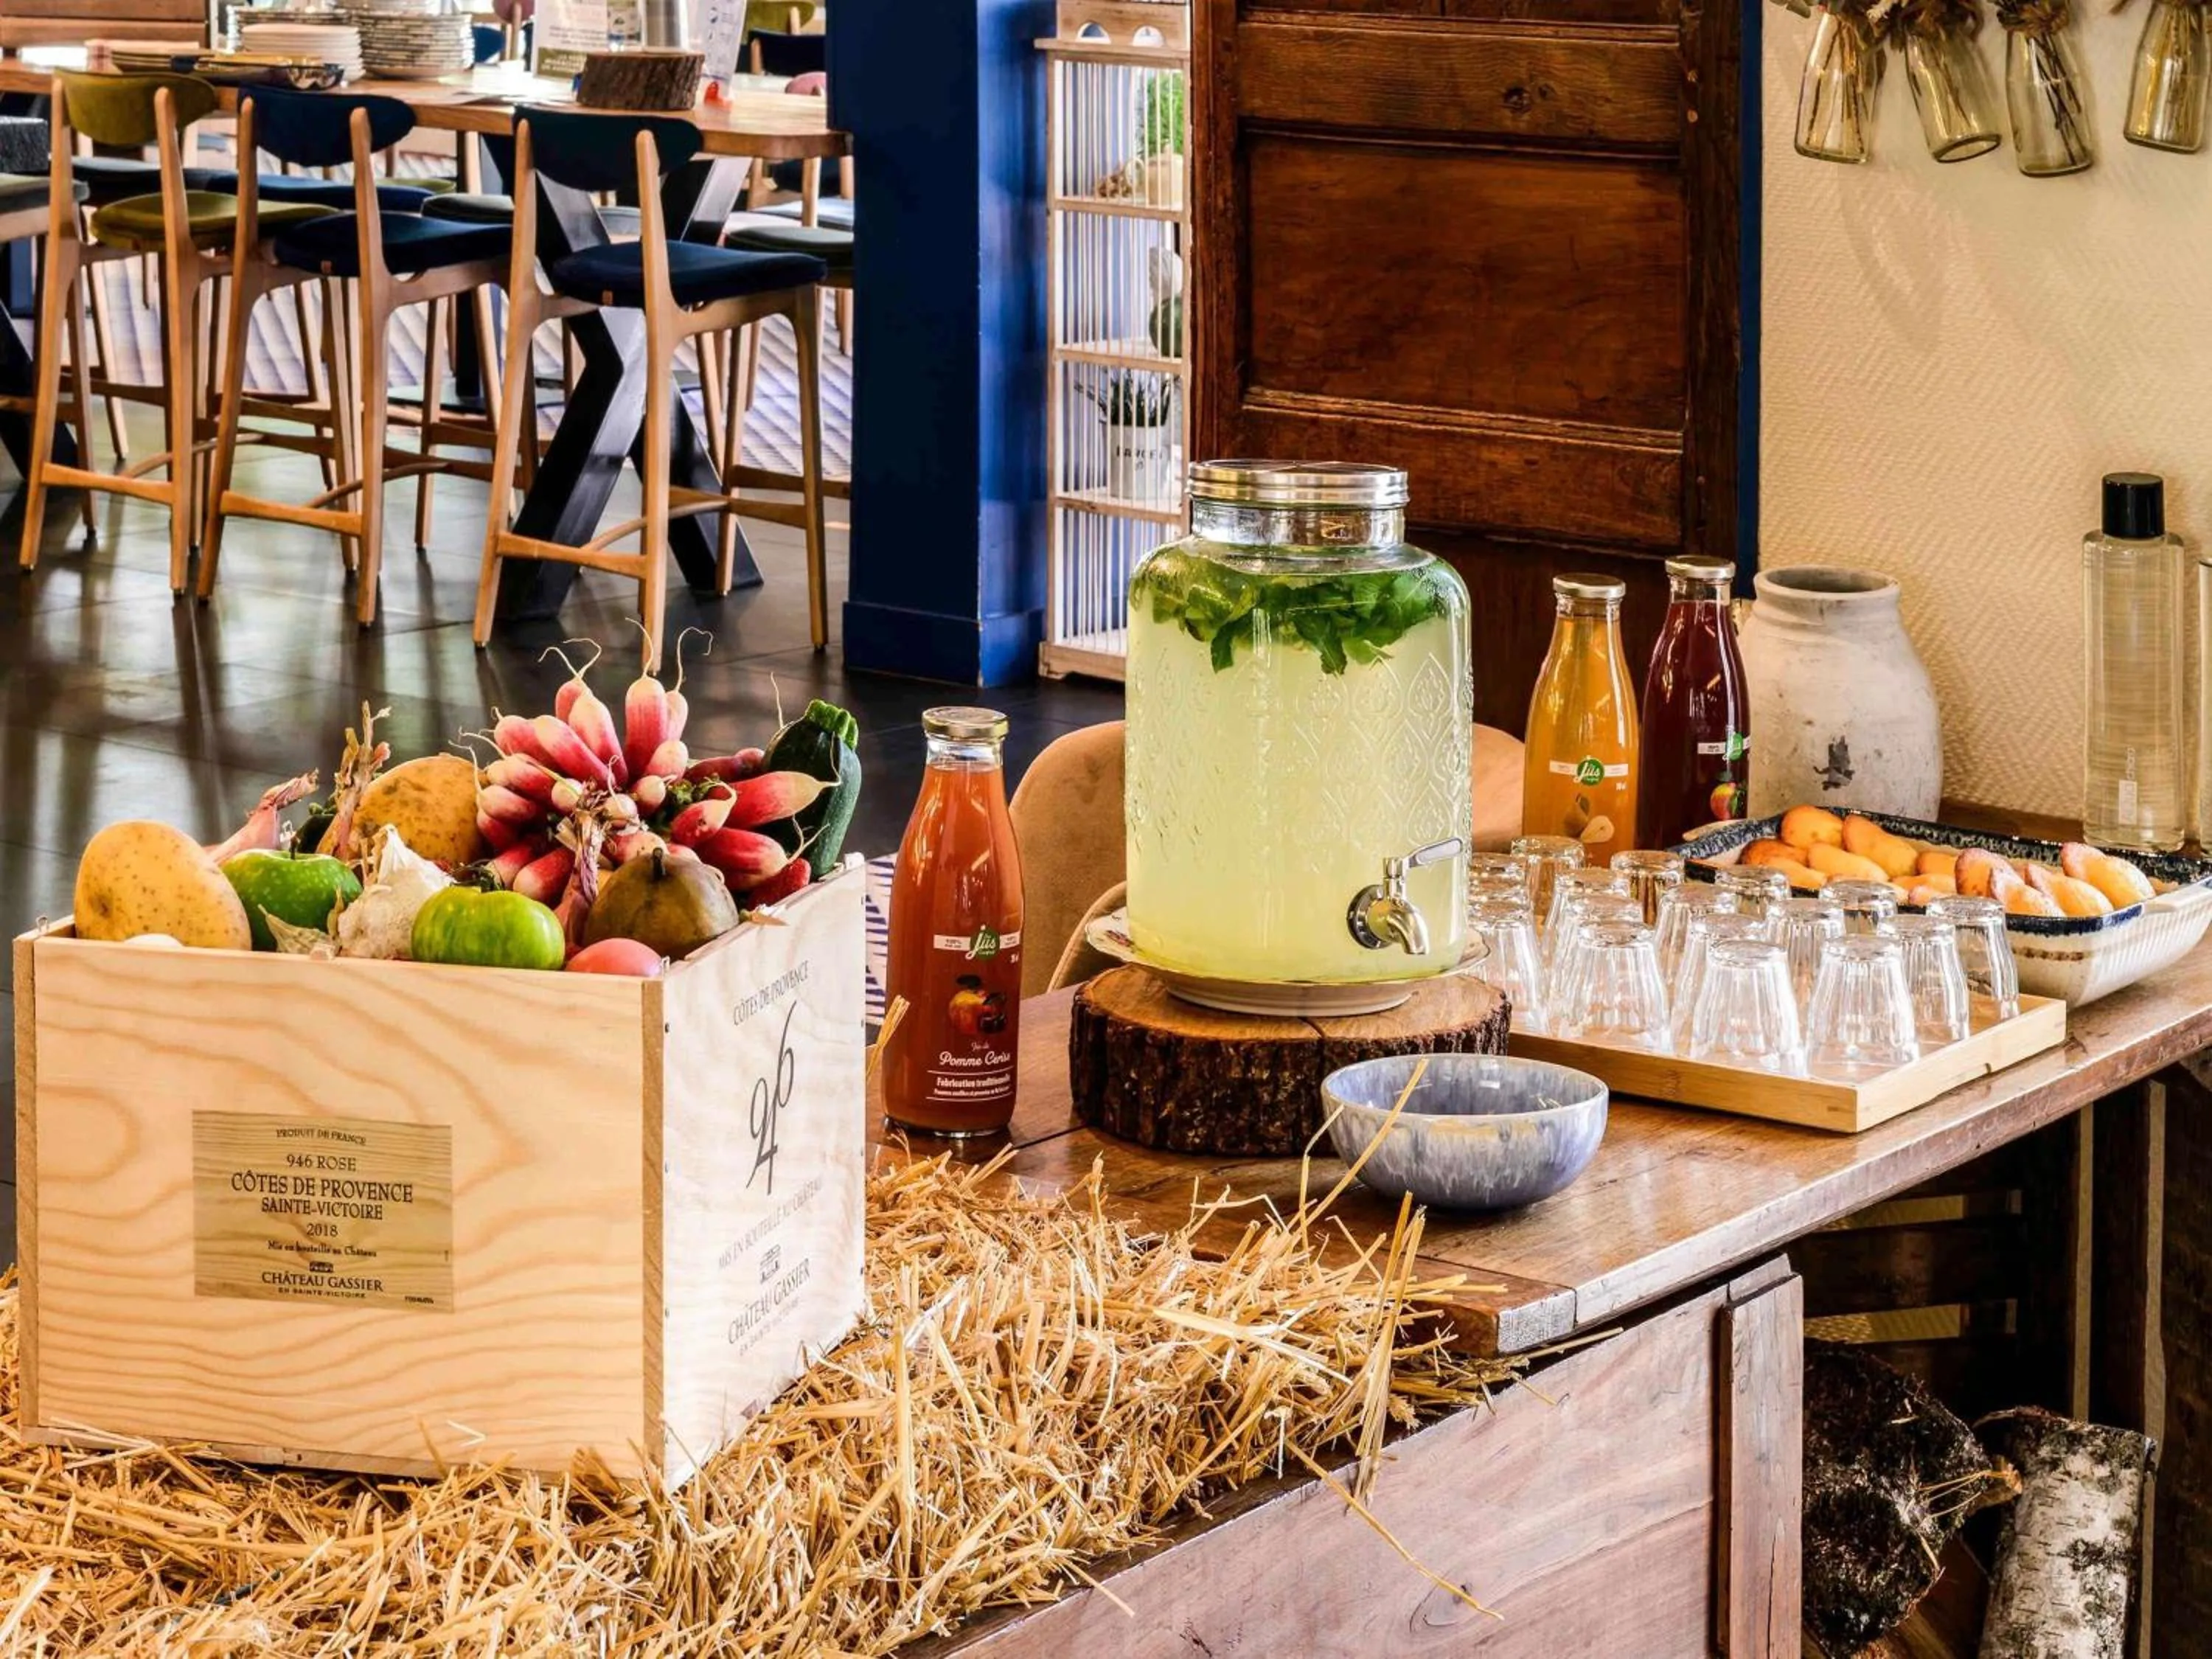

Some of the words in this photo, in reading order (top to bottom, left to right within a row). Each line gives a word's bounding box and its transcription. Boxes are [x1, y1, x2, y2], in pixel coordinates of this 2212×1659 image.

[733, 992, 758, 1026] CÔTES
[759, 985, 770, 1009] DE
[771, 959, 809, 1001] PROVENCE
[939, 1051, 983, 1067] Pomme
[276, 1128, 315, 1138] PRODUIT
[317, 1129, 330, 1138] DE
[331, 1130, 366, 1145] FRANCE
[286, 1154, 313, 1168] 946
[317, 1155, 357, 1172] ROSE
[231, 1170, 288, 1194] CÔTES
[293, 1178, 316, 1196] DE
[321, 1180, 414, 1203] PROVENCE
[261, 1197, 383, 1220] SAINTE-VICTOIRE
[306, 1223, 338, 1237] 2018
[268, 1240, 283, 1251] Mis
[296, 1242, 331, 1254] bouteille
[344, 1245, 377, 1257] Château
[262, 1270, 324, 1287] CHÂTEAU
[327, 1276, 384, 1292] GASSIER
[728, 1289, 773, 1345] CHÂTEAU
[773, 1257, 811, 1307] GASSIER
